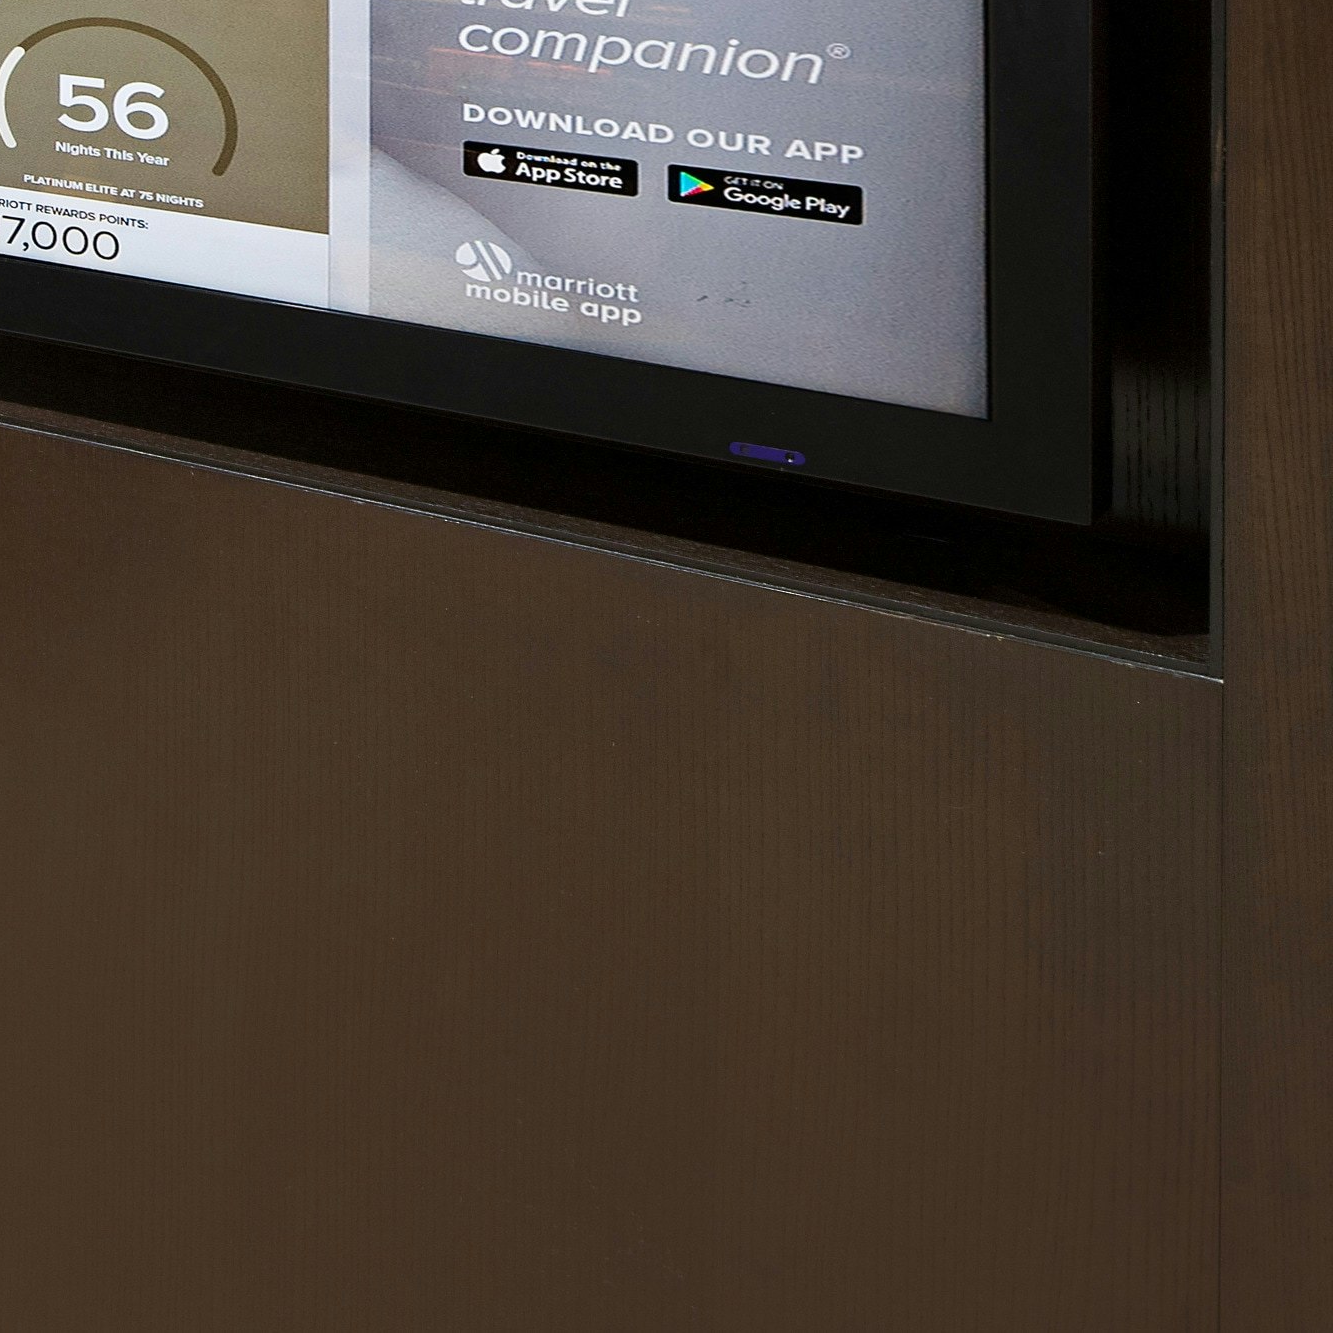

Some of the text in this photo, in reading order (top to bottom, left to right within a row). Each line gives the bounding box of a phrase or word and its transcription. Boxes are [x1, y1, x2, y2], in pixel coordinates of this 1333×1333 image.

[57, 73, 169, 141] 56
[462, 103, 864, 165] DOWNLOAD OUR APP
[55, 141, 170, 167] Nights This Year
[516, 151, 578, 166] Download
[23, 174, 205, 208] PLATINUM ELITE AT 75 NIGHTS
[515, 162, 623, 188] App Store
[35, 204, 95, 221] REWARDS
[99, 214, 149, 230] POINTS:
[724, 187, 850, 218] Google Play
[517, 270, 639, 303] marriott
[466, 283, 642, 326] mobile app
